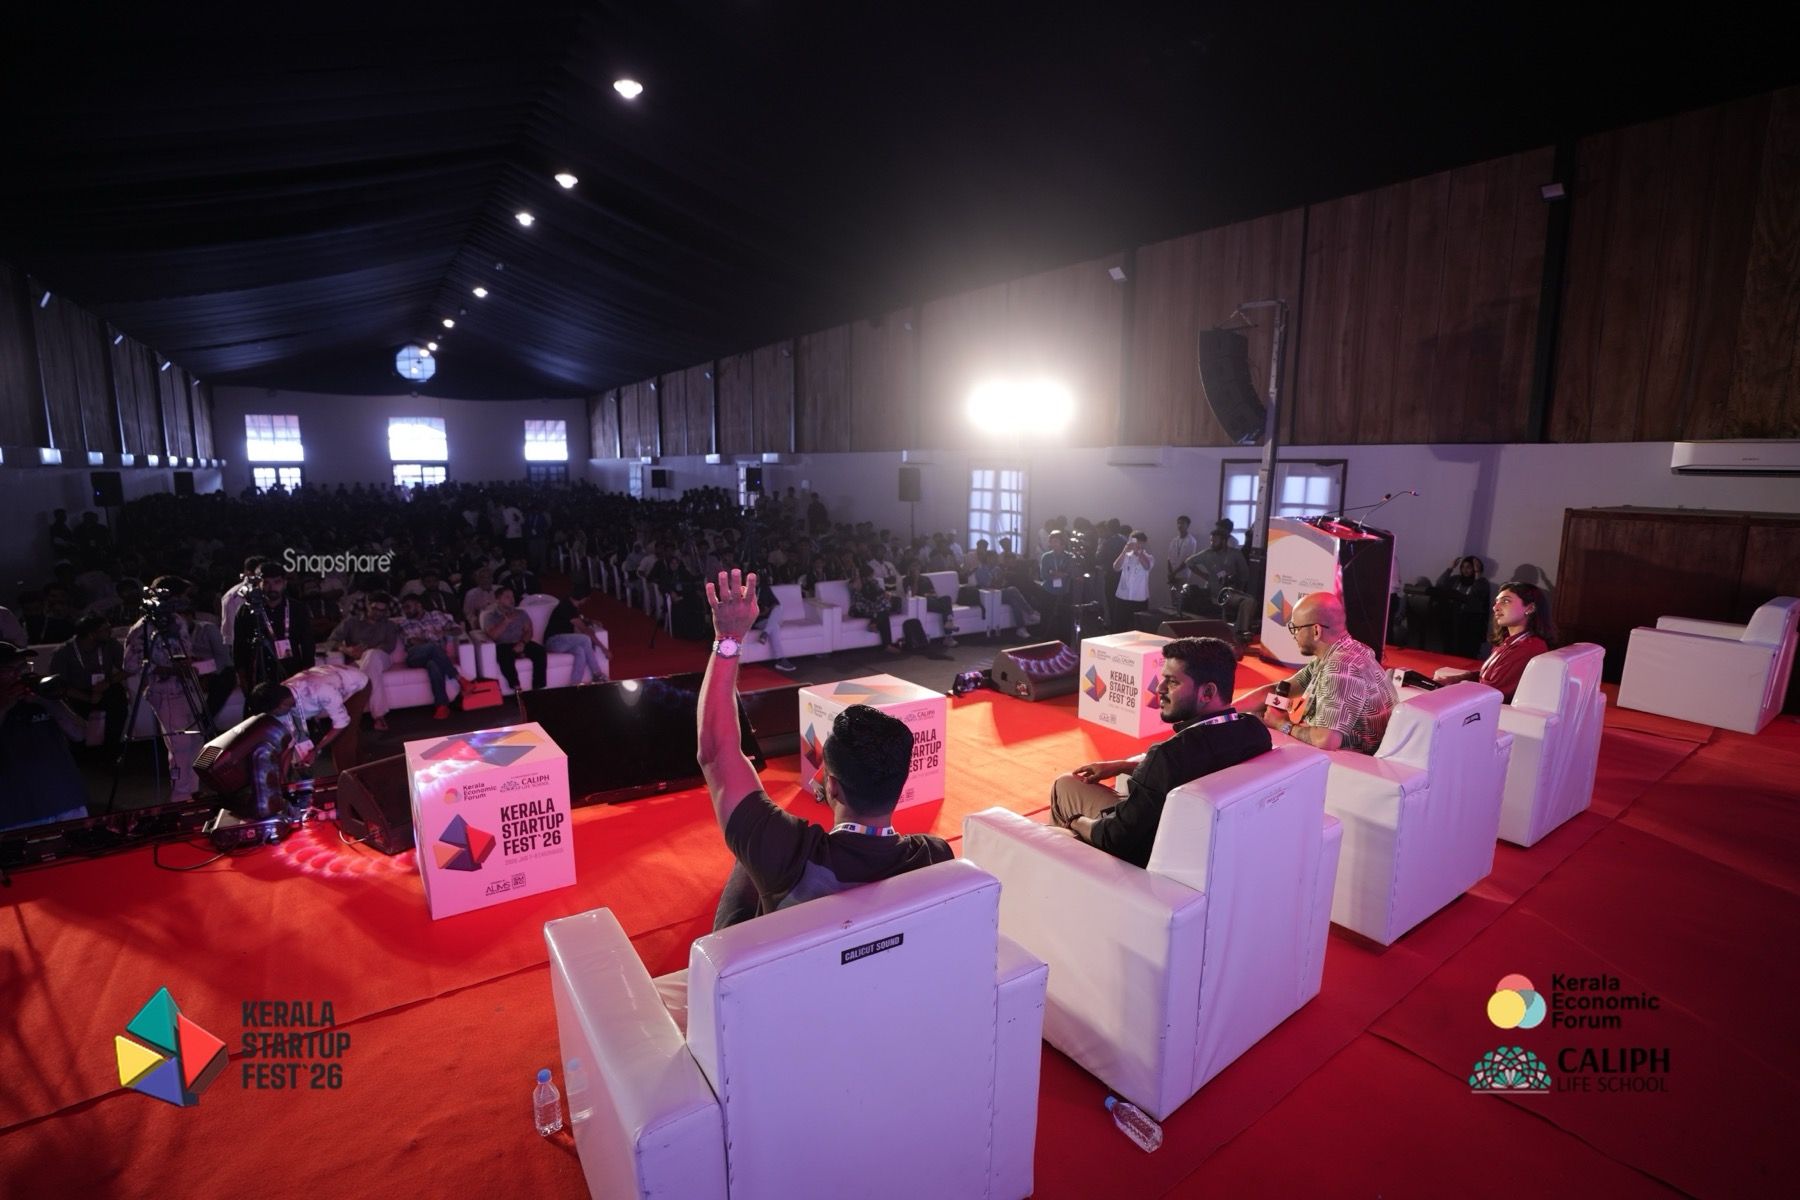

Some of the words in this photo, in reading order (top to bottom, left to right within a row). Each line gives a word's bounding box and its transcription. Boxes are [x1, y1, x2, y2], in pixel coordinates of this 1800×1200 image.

[1110, 670, 1135, 686] KERALA
[1110, 681, 1138, 697] STARTUP
[913, 728, 937, 745] RALA
[912, 741, 941, 759] ARTUP
[463, 782, 485, 790] Kerala
[521, 774, 549, 785] CALIPH
[463, 786, 497, 796] Economic
[464, 793, 486, 801] Forum
[501, 798, 555, 822] KERALA
[502, 812, 564, 839] STARTUP
[844, 944, 875, 961] CALICUT
[876, 936, 900, 951] SOUND
